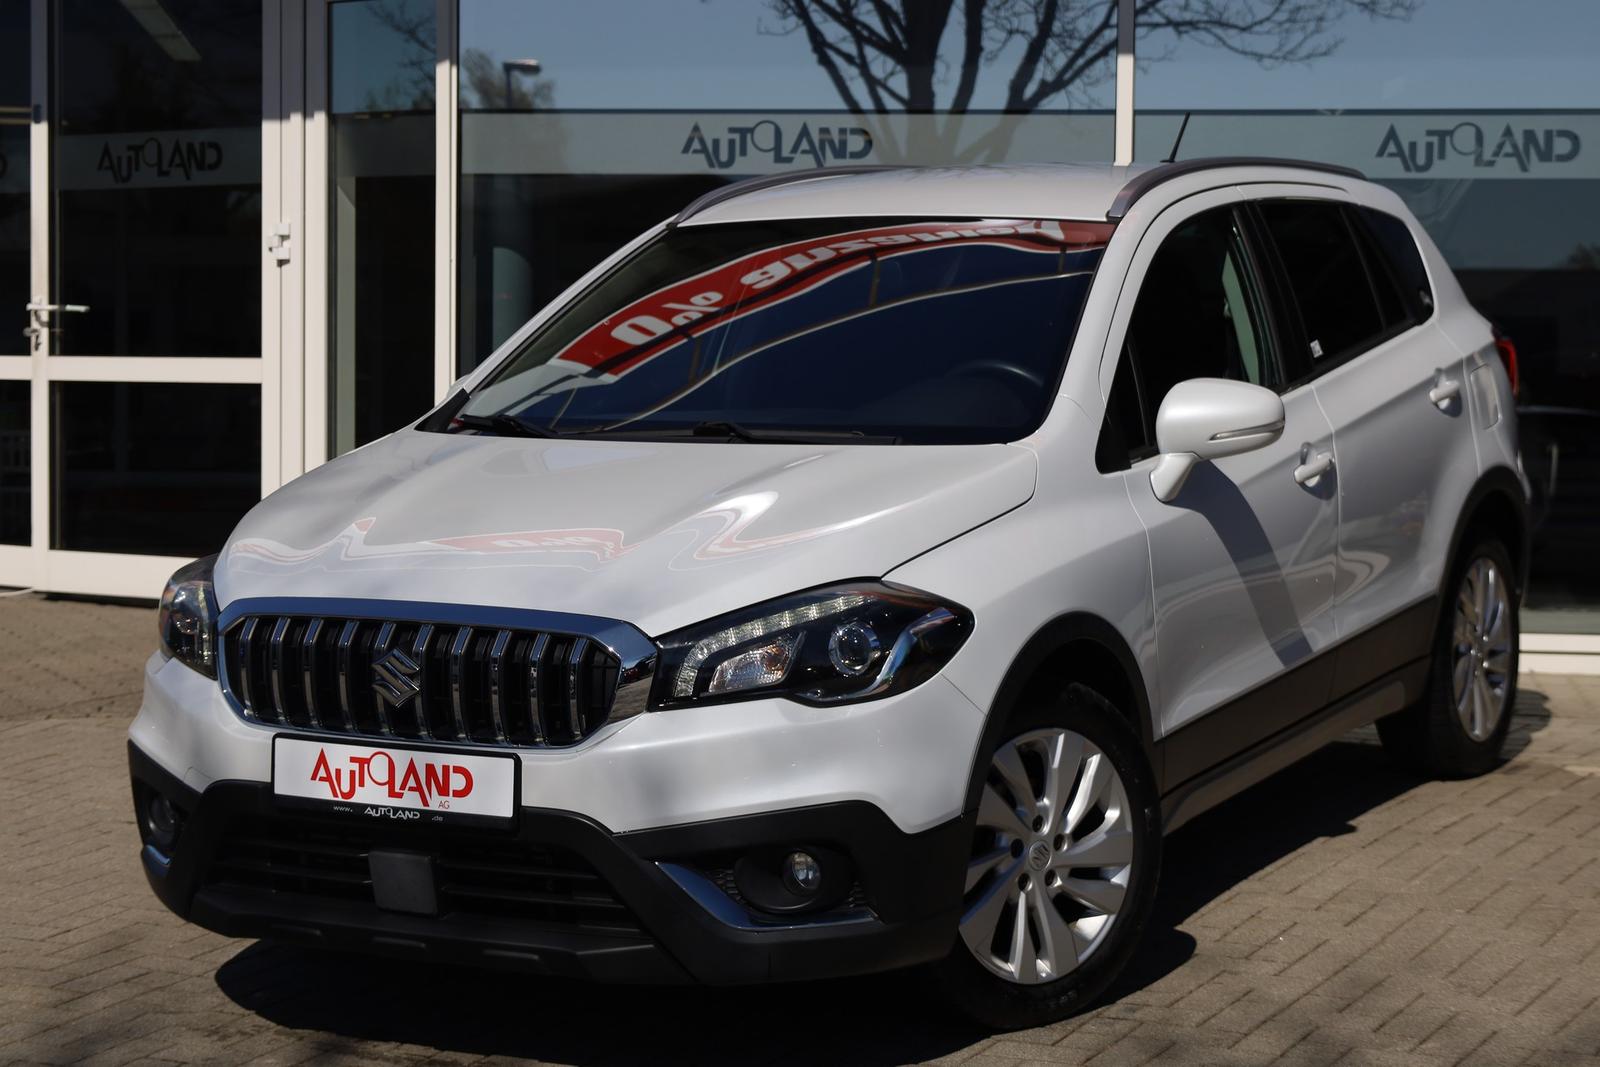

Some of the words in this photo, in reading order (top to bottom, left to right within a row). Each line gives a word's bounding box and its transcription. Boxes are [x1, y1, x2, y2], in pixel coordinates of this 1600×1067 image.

[97, 137, 223, 184] AUTOLAND
[681, 119, 873, 169] AUTOLAND
[1375, 121, 1581, 173] AUTOLAND
[310, 747, 474, 807] AUTOLAND
[364, 806, 420, 820] AUTOLAND
[438, 800, 450, 810] AG
